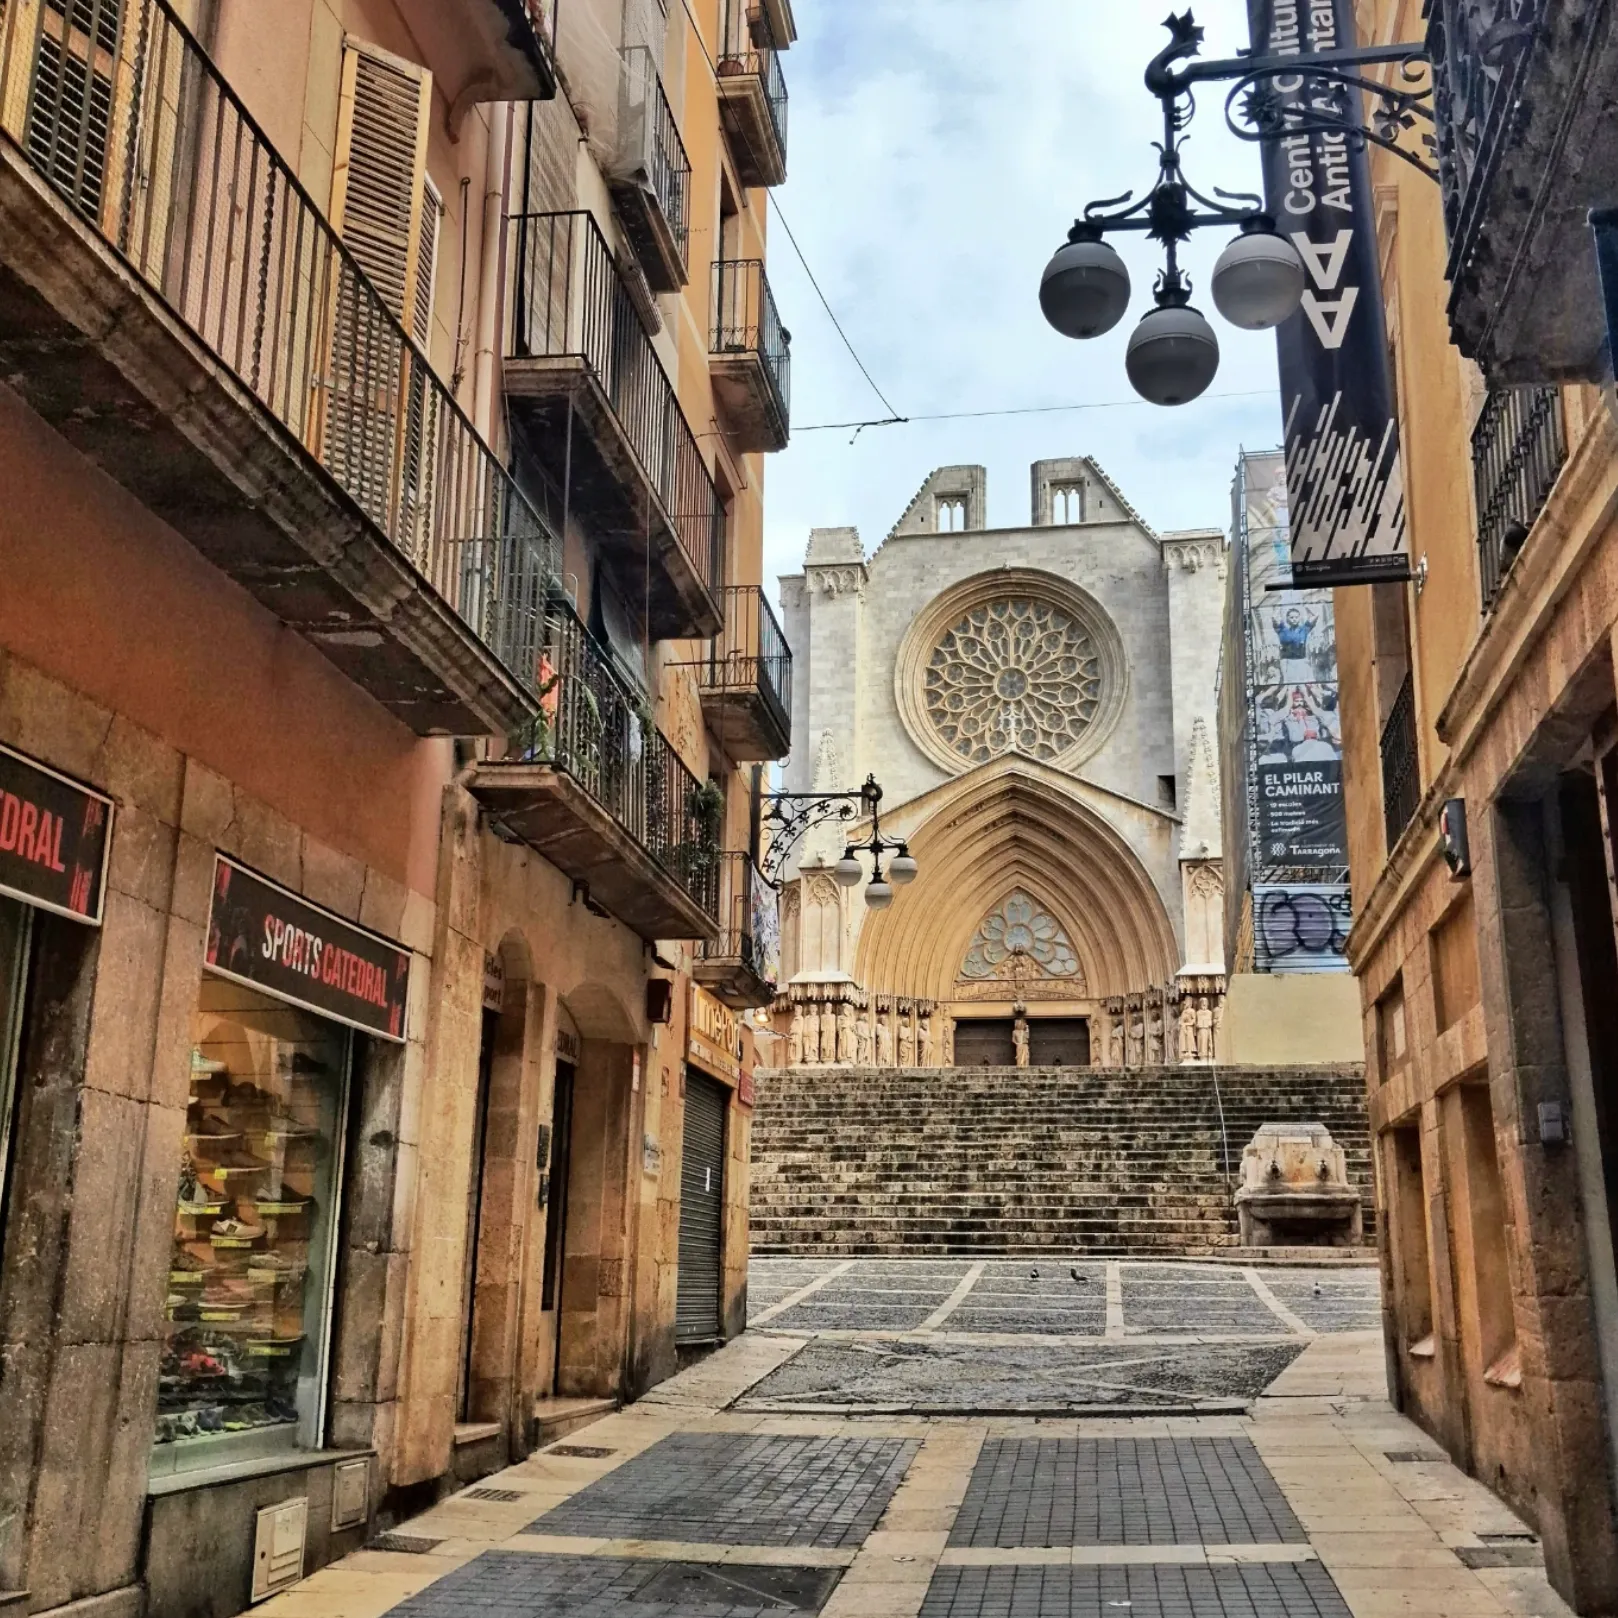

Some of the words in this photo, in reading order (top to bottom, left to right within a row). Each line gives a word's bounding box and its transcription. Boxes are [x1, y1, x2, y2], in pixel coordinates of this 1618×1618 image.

[1264, 774, 1281, 785] EL
[1283, 771, 1323, 784] PILAR
[1265, 782, 1340, 797] CAMINANT
[0, 788, 65, 872] DRAL
[262, 914, 322, 979] SPORTS
[323, 943, 388, 1008] CATEDRAL
